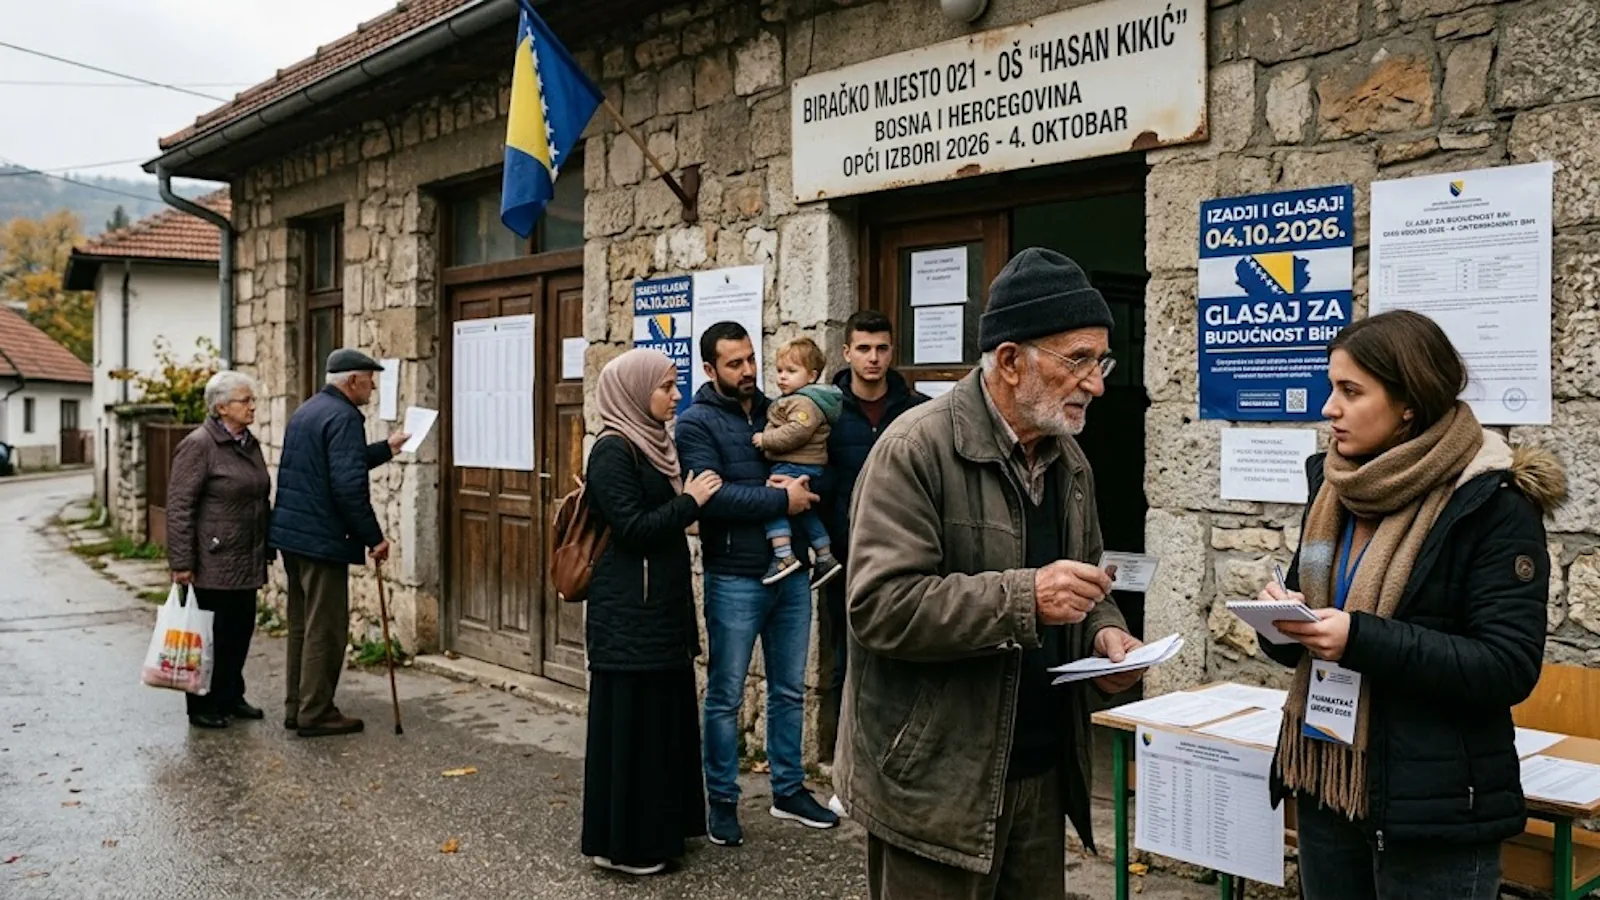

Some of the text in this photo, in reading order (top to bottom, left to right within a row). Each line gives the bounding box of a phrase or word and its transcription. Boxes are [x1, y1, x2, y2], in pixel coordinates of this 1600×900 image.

[803, 82, 869, 124] BIRAČKO
[875, 67, 941, 109] MJESTO
[946, 58, 976, 93] 021
[998, 40, 1023, 82] OŠ
[875, 80, 1082, 142] BOSNA I HERCEGOVINA
[843, 146, 879, 177] OPĆI
[885, 140, 940, 170] IZBORI
[946, 132, 989, 160] 2026
[1009, 125, 1025, 149] 4.
[1032, 106, 1128, 145] OKTOBAR
[1207, 195, 1344, 224] IZADJI I GLASAJ!
[1205, 216, 1345, 250] 04.10.2026.
[1205, 299, 1345, 327] GLASAJ ZA
[674, 342, 690, 356] ZA
[1205, 325, 1305, 345] BUDUĆNOST
